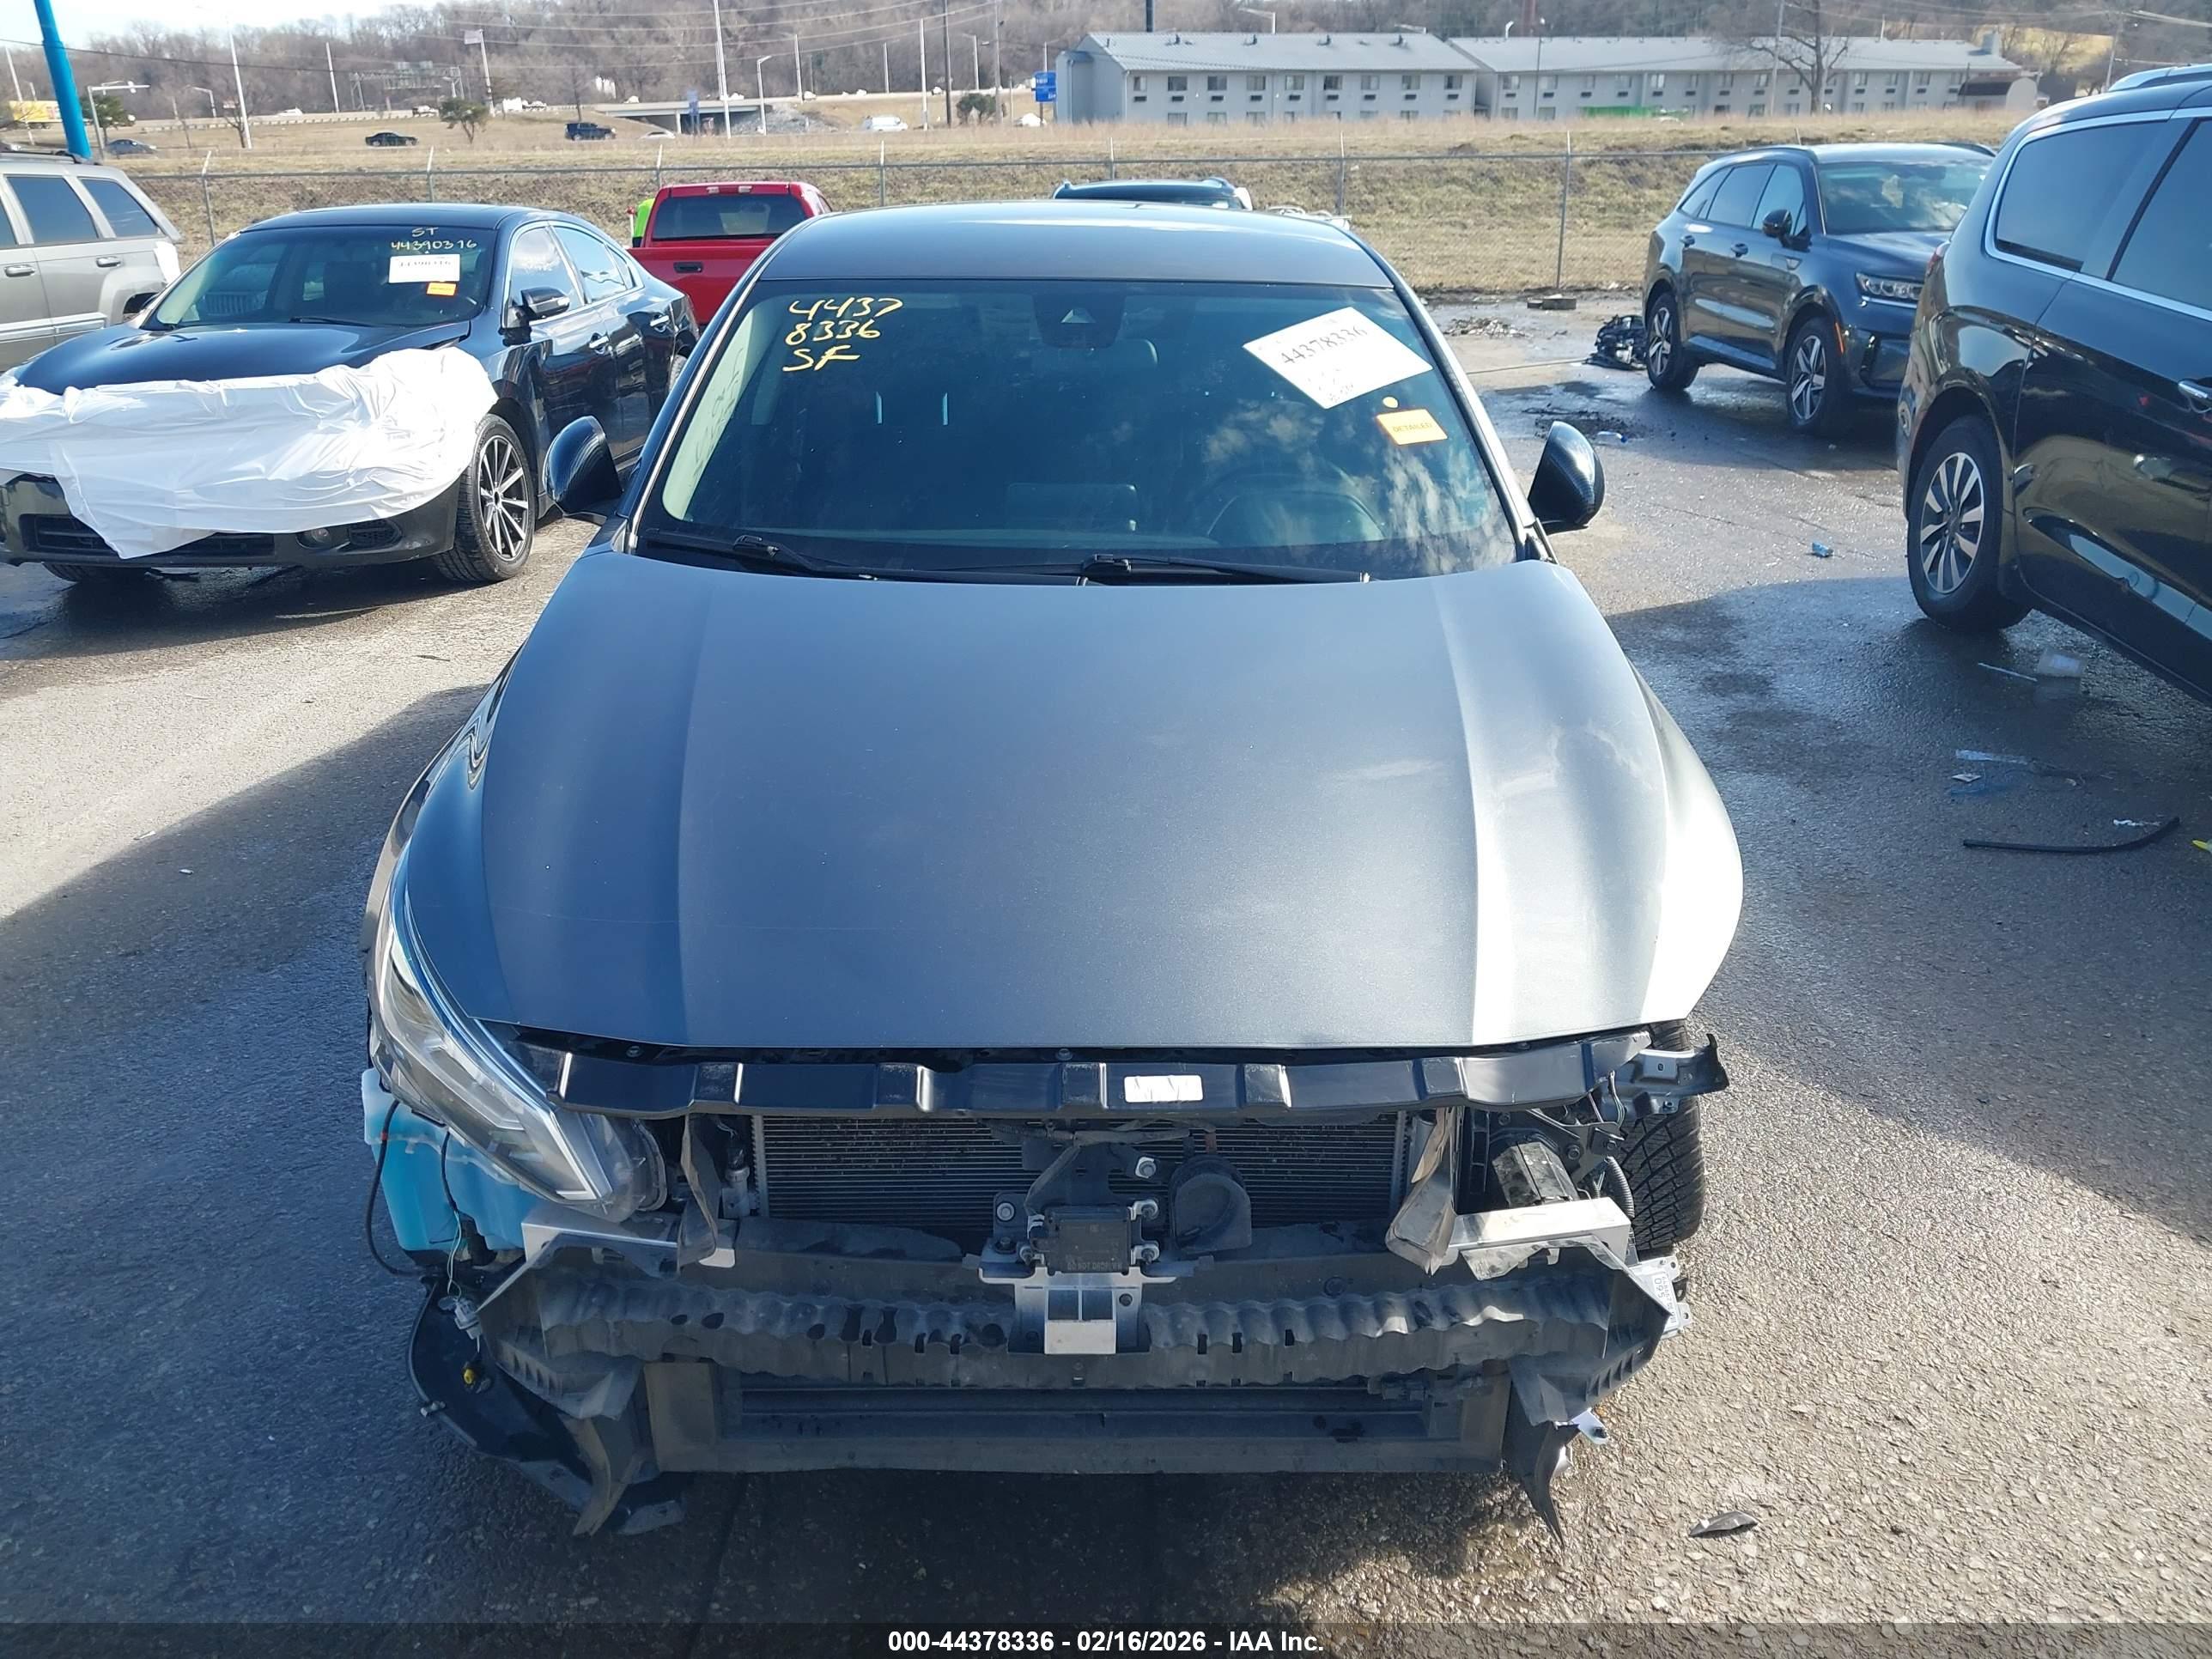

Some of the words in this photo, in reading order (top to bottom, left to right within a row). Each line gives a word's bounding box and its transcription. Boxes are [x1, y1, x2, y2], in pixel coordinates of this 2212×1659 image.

[411, 227, 439, 238] ST
[788, 297, 903, 320] 4437
[785, 319, 881, 345] 8336
[1280, 325, 1368, 365] 44378336
[782, 344, 861, 371] SF
